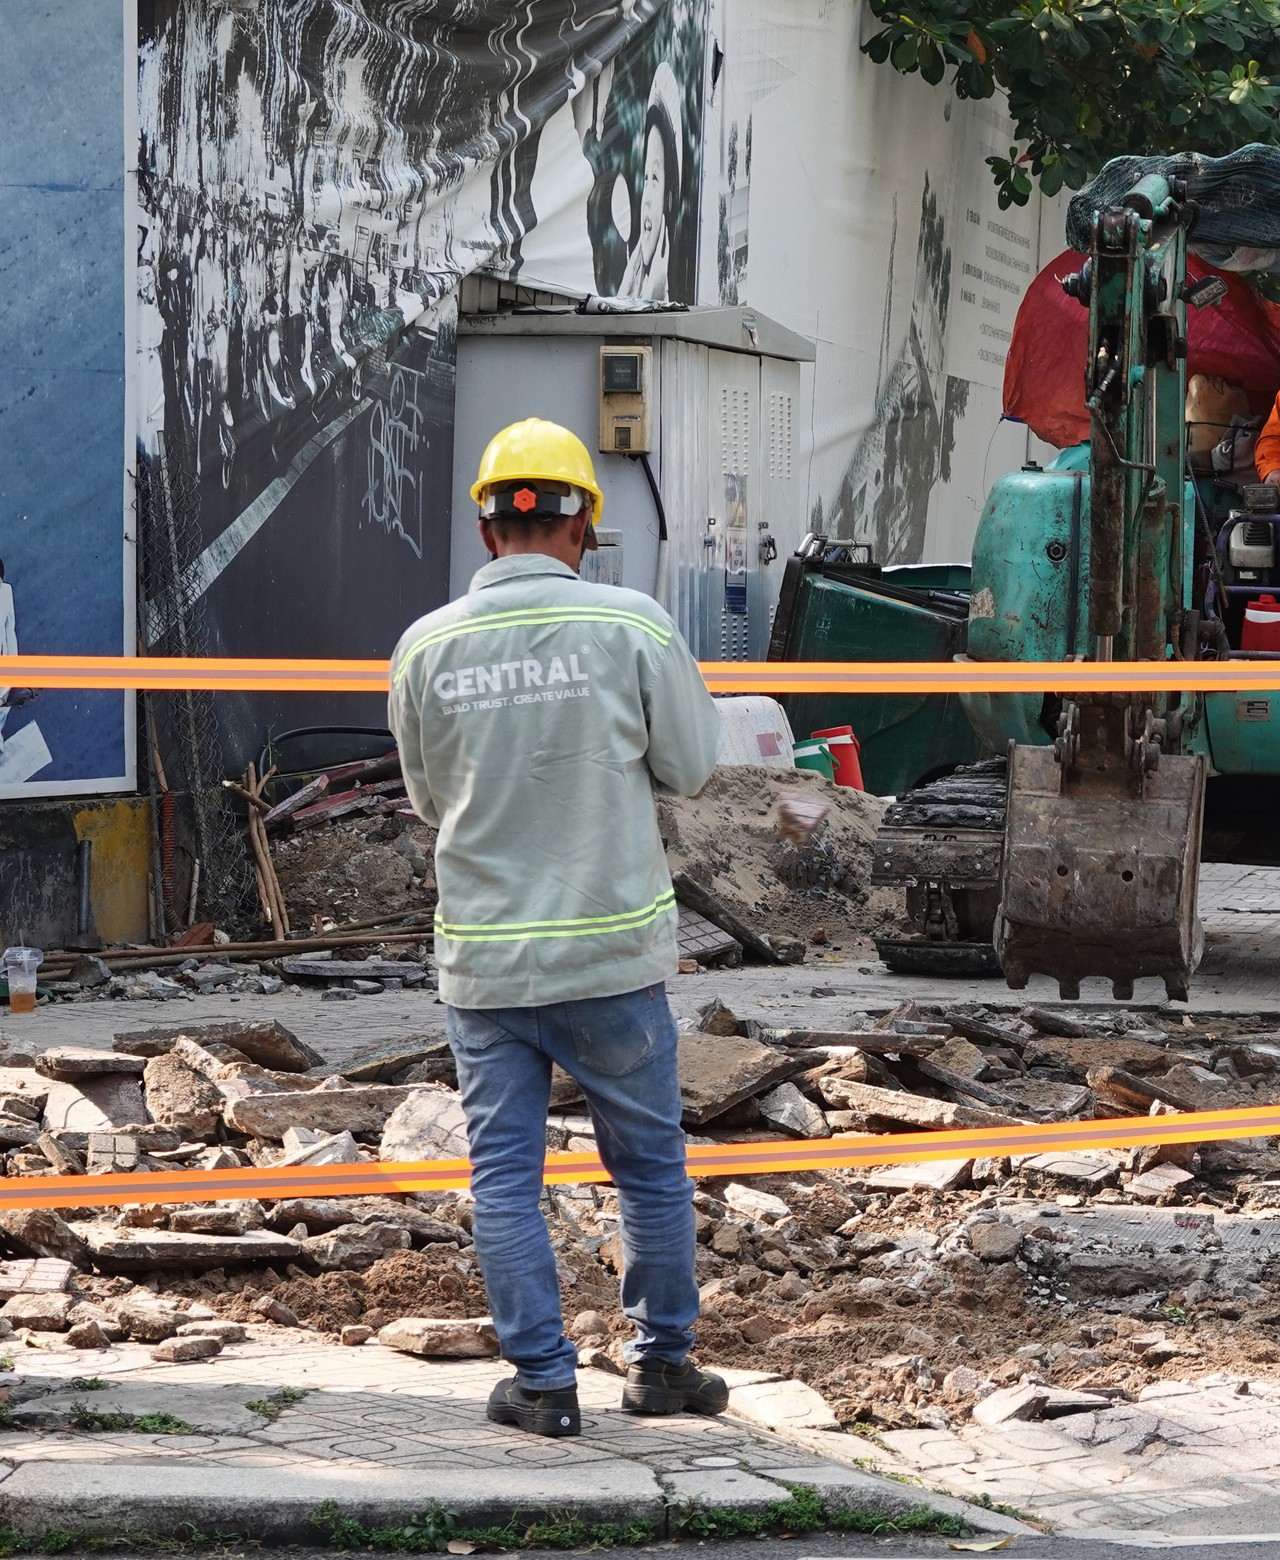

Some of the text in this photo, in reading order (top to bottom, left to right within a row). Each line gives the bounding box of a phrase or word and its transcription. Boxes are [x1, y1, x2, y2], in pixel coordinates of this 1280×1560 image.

[433, 653, 589, 700] CENTRAL
[442, 703, 470, 715] BUILD
[513, 691, 554, 705] CREATE
[555, 687, 590, 700] VALUE
